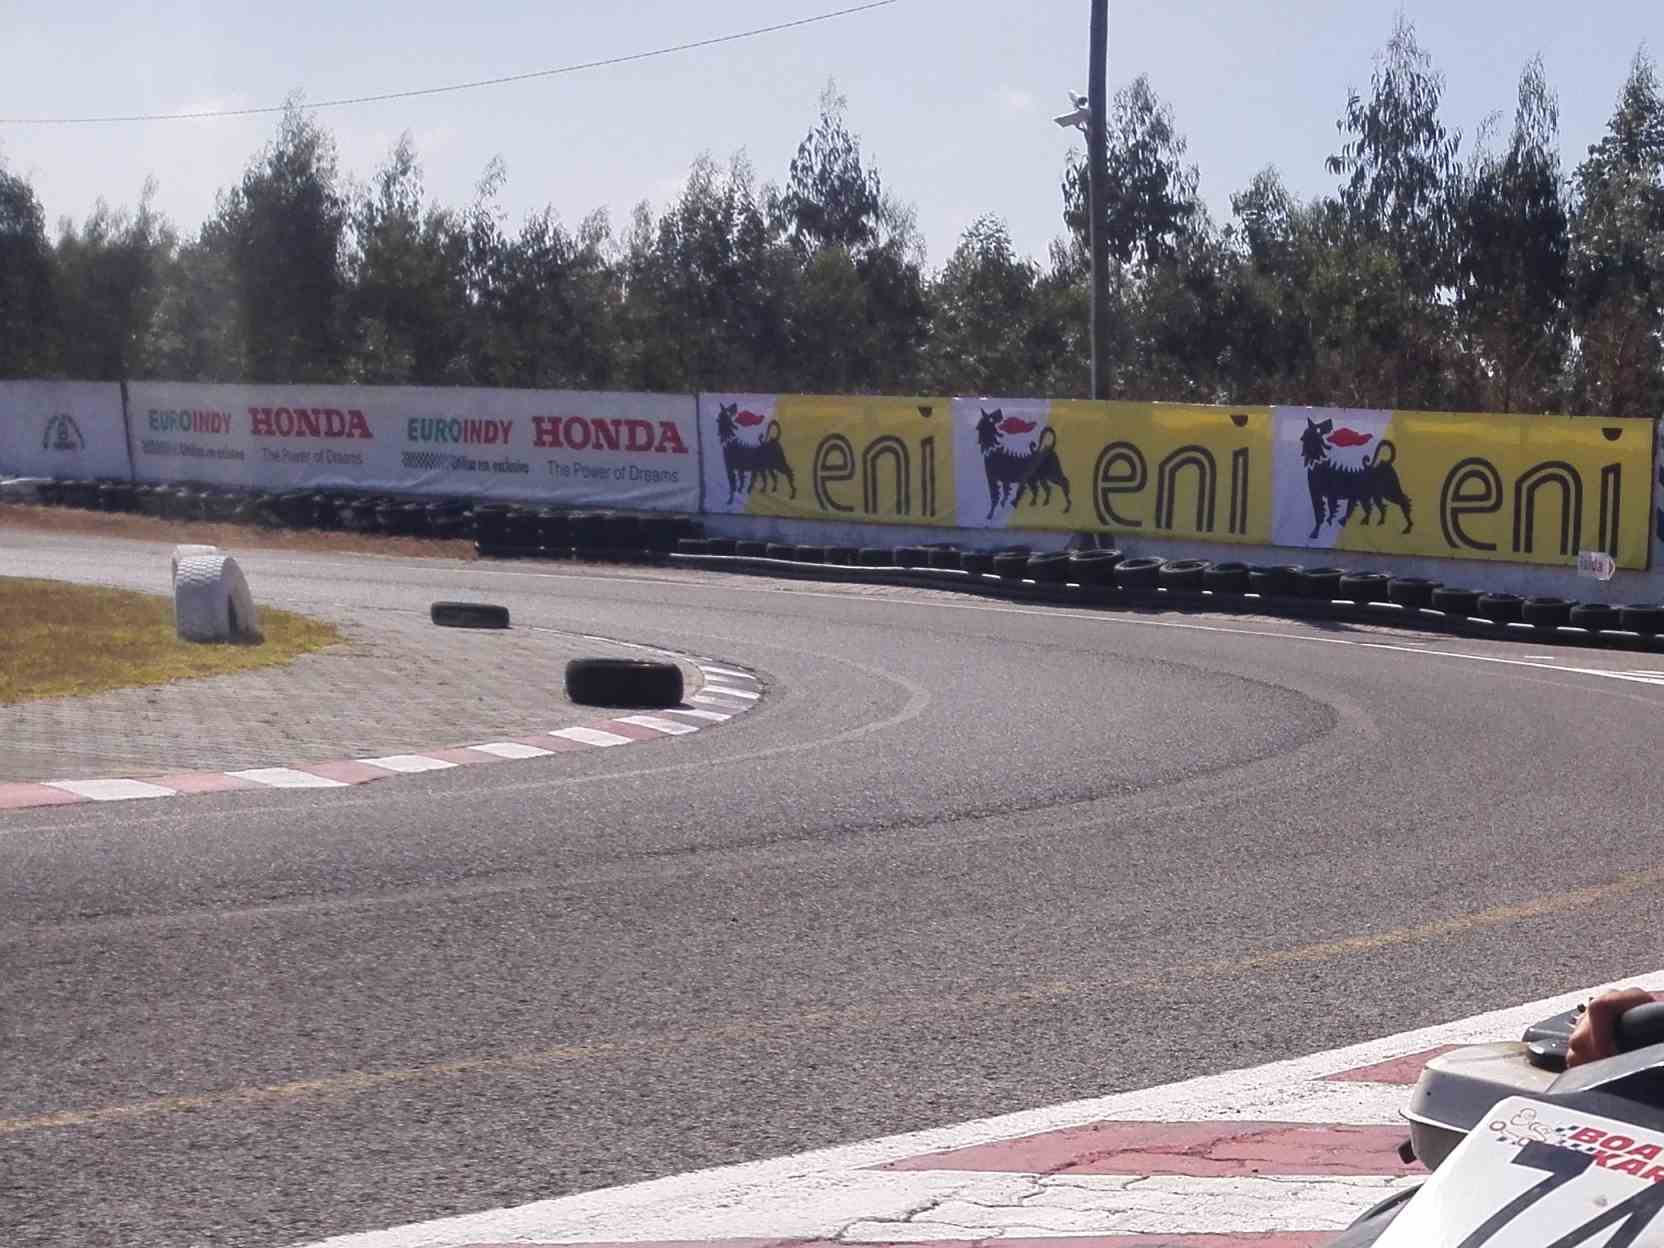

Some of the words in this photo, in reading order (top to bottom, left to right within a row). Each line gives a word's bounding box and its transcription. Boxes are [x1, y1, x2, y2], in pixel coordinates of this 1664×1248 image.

[148, 408, 232, 434] EUROINDY
[248, 407, 373, 439] HONDA
[407, 418, 513, 444] EUROINDY
[532, 416, 689, 454] HONDA
[547, 460, 569, 477] The
[573, 462, 610, 481] Power
[629, 465, 679, 483] Dreams
[813, 406, 936, 518] eni
[1093, 415, 1249, 534] eni
[1440, 428, 1623, 558] eni
[1567, 1127, 1664, 1160] BOA
